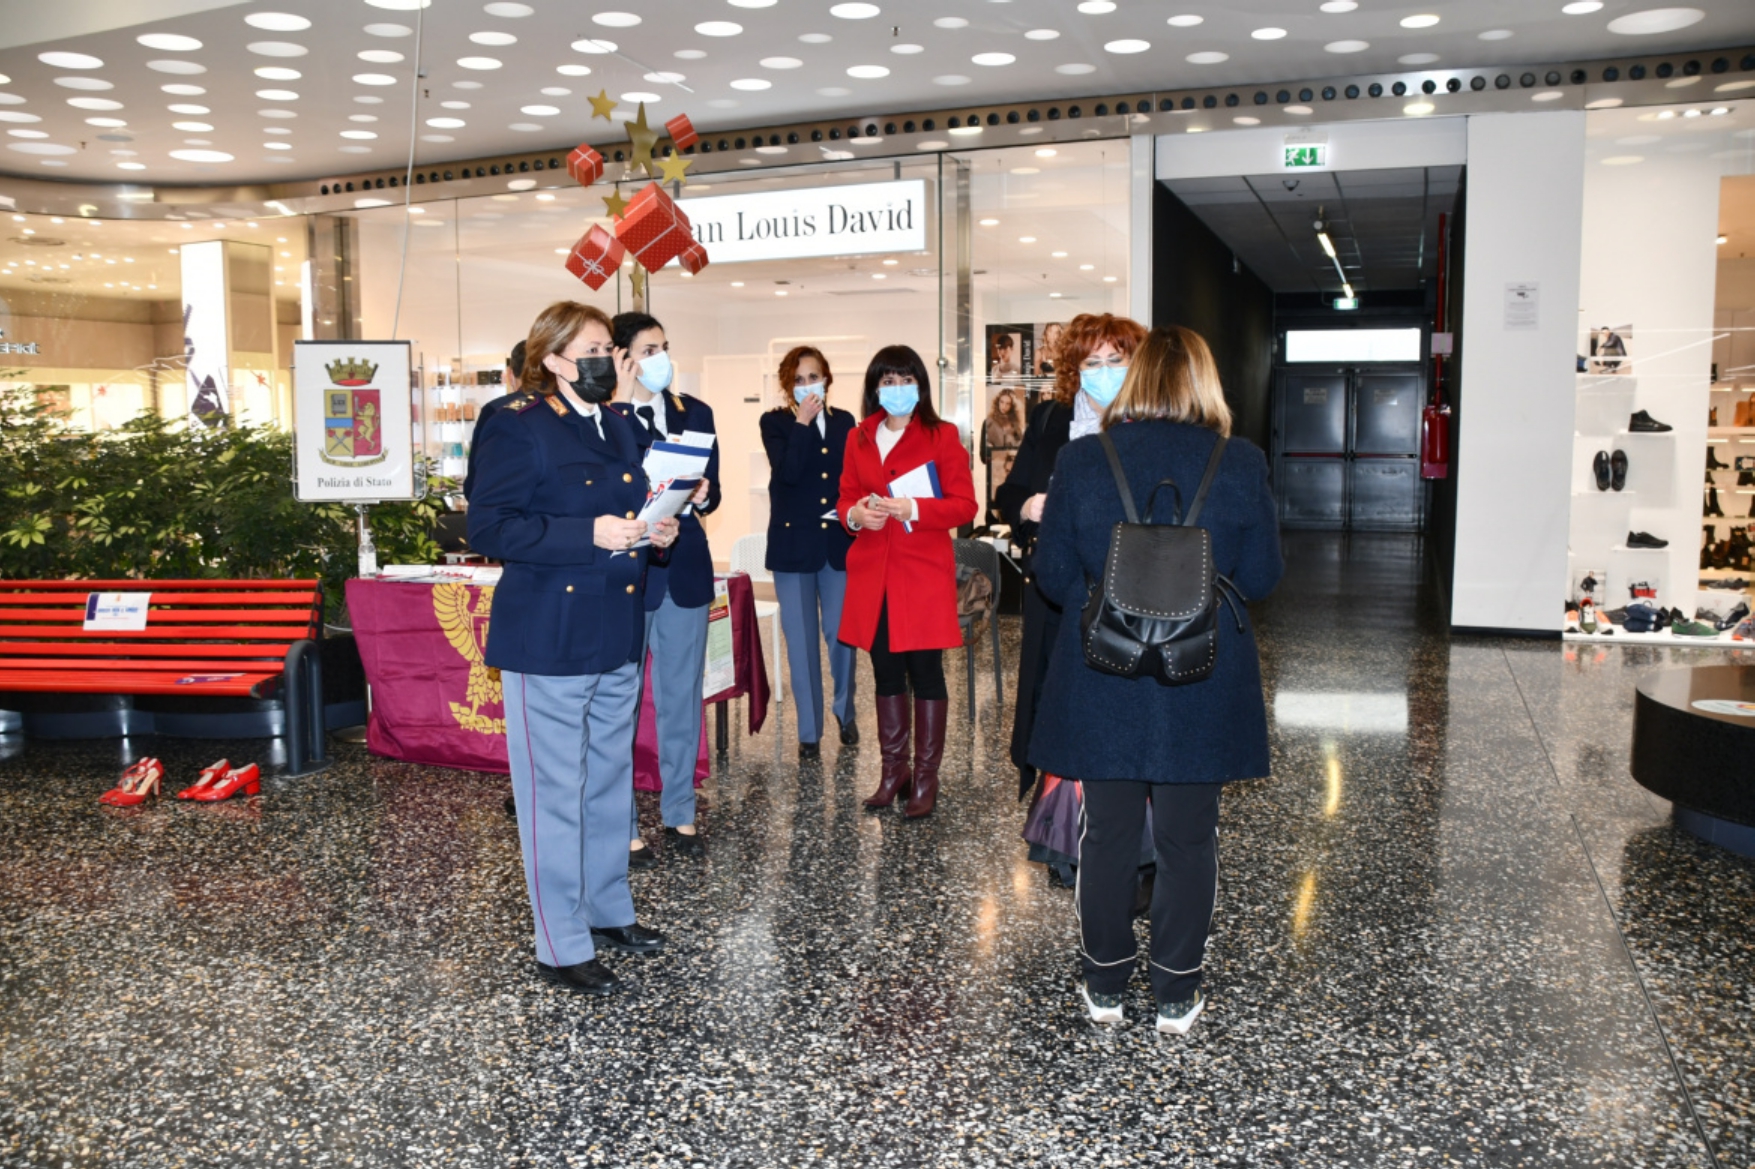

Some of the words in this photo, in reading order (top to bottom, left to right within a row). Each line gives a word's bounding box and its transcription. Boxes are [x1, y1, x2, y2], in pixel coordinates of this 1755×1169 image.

[692, 221, 724, 244] an
[736, 208, 817, 242] Louis
[827, 199, 914, 236] David
[317, 477, 351, 488] Polizia
[353, 477, 364, 488] di
[365, 477, 392, 487] Stato
